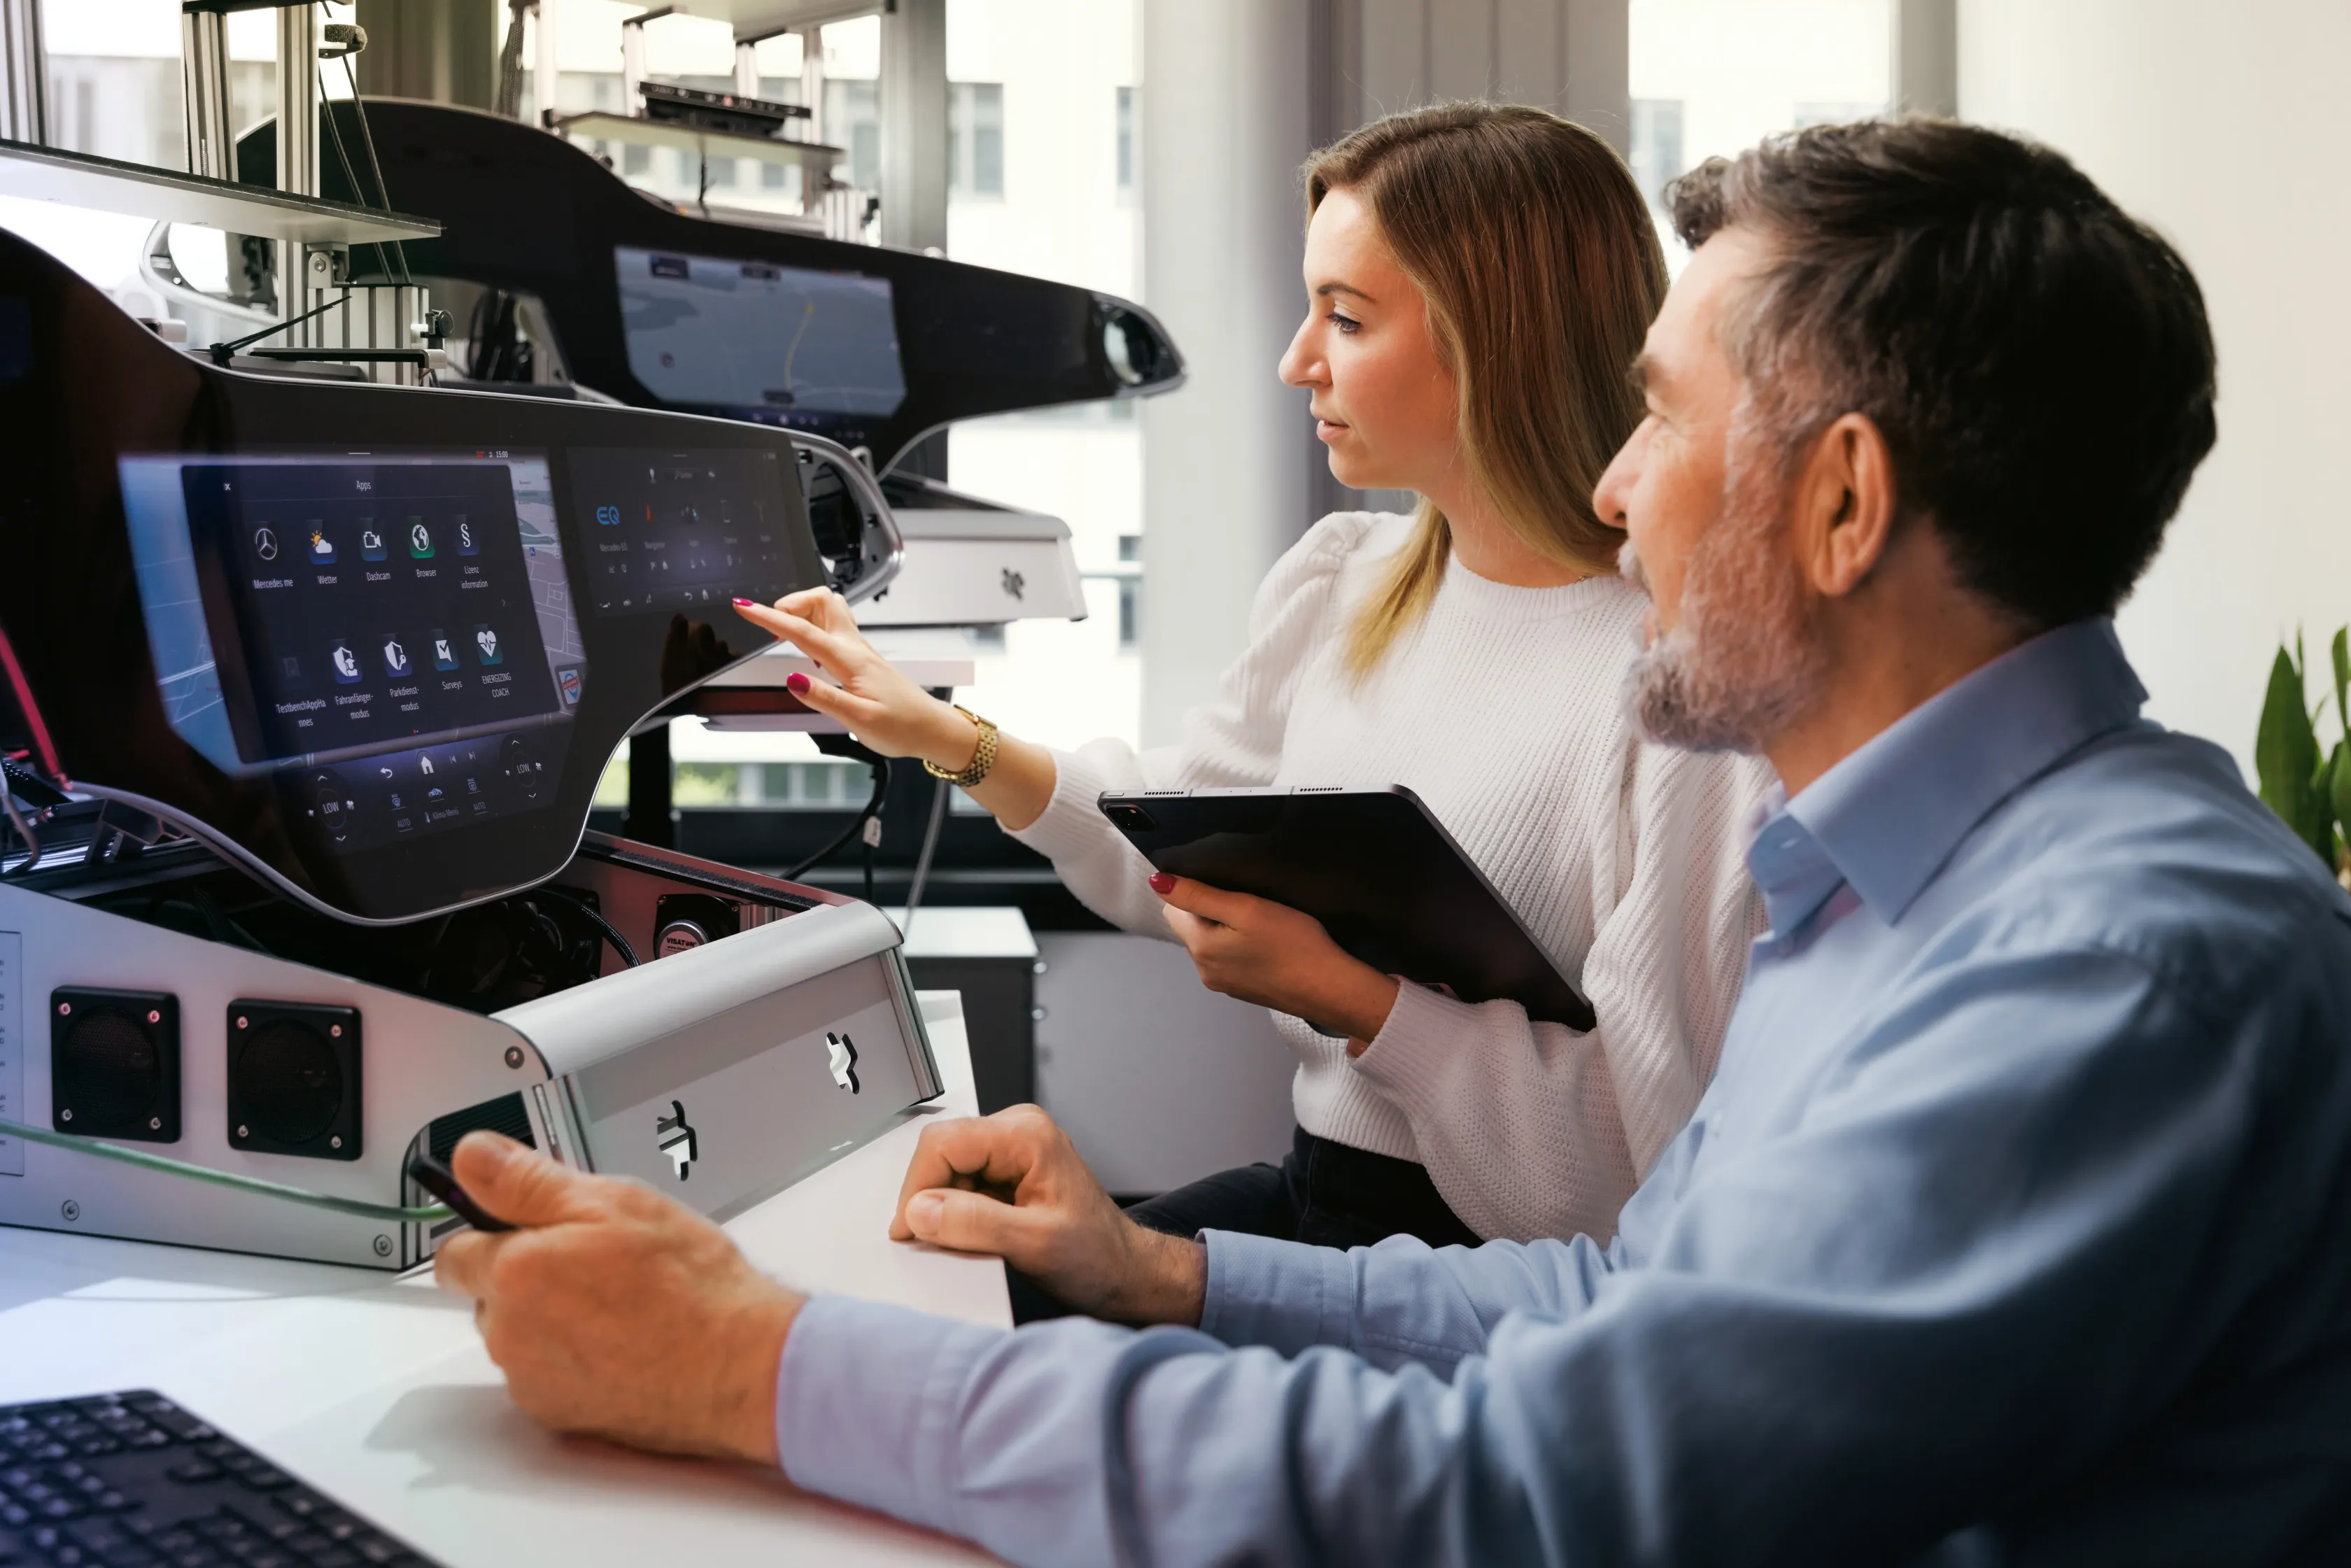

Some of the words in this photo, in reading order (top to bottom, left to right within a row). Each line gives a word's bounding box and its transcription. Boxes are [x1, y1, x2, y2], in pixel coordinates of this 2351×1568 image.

[356, 480, 372, 491] Apps
[597, 505, 620, 525] EQ
[416, 569, 437, 578] Browser
[464, 565, 480, 574] Lizenz
[318, 575, 337, 585] Wetter
[366, 572, 390, 581] Dashcam
[253, 578, 283, 589] Mercedes
[284, 579, 294, 587] me
[460, 579, 488, 589] information
[481, 672, 511, 684] ENERGIZING
[442, 681, 463, 691] Surveys
[390, 686, 420, 698] Parkdienst-
[492, 688, 509, 698] COACH
[335, 693, 374, 705] Fahranfänger-
[276, 699, 326, 714] TestbenchAppHa
[401, 702, 420, 712] modus
[351, 709, 370, 720] modus
[298, 718, 313, 728] nnes
[516, 763, 530, 775] LOW
[322, 801, 339, 814] LOW
[473, 801, 486, 812] AUTO
[397, 818, 411, 828] AUTO
